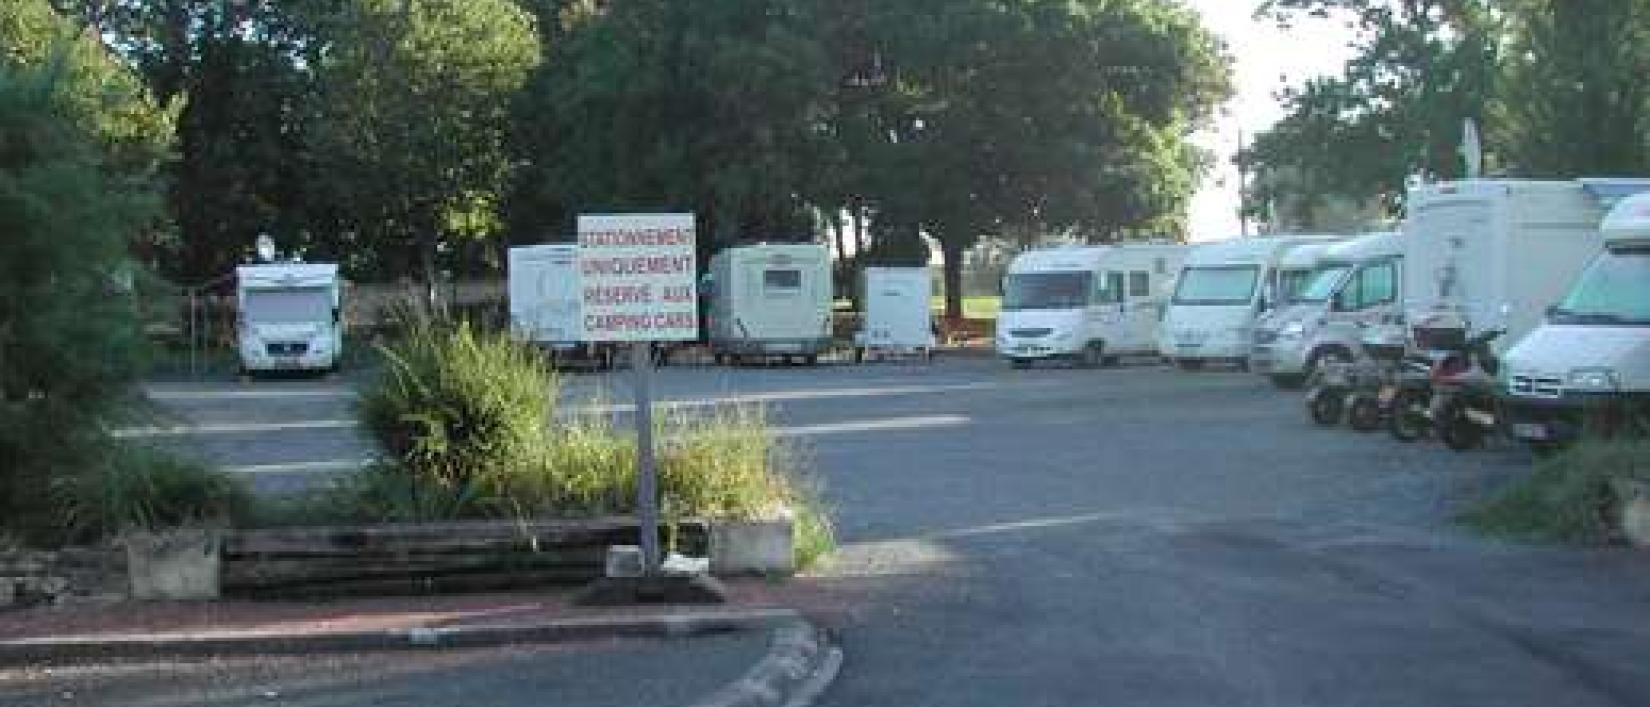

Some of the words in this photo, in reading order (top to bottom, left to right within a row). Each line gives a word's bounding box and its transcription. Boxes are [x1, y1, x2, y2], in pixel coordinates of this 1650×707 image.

[579, 228, 694, 248] STATIONNEMENT
[581, 255, 692, 276] UNIQUEMENT
[662, 285, 693, 303] AUX
[583, 312, 651, 332] CAMPING
[653, 311, 695, 329] CARS
